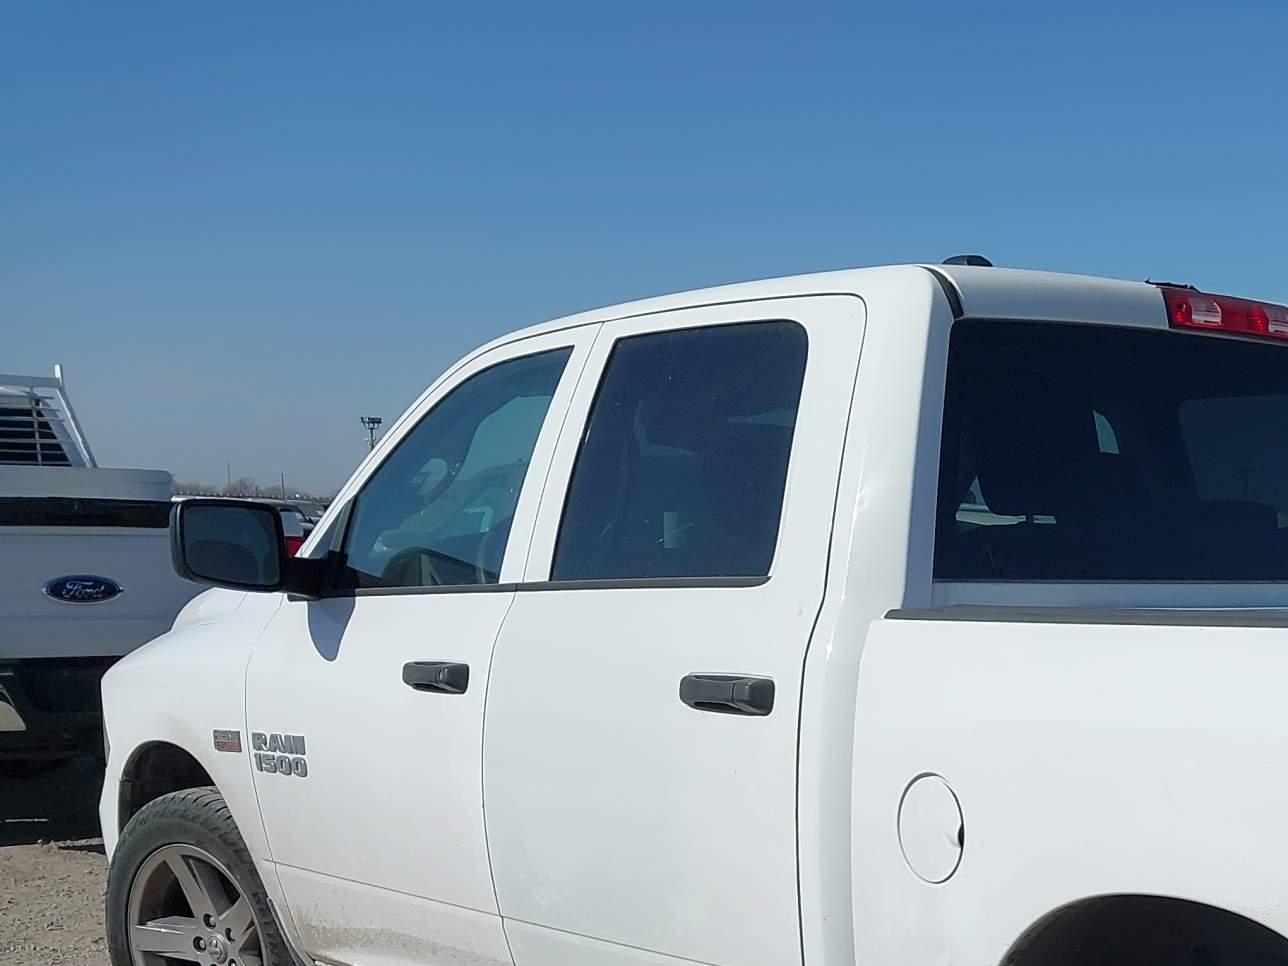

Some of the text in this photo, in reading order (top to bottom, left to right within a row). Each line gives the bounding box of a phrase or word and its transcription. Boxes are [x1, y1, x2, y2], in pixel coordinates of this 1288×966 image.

[61, 580, 105, 599] Ford
[251, 731, 306, 756] RAM
[253, 752, 308, 778] 1500
